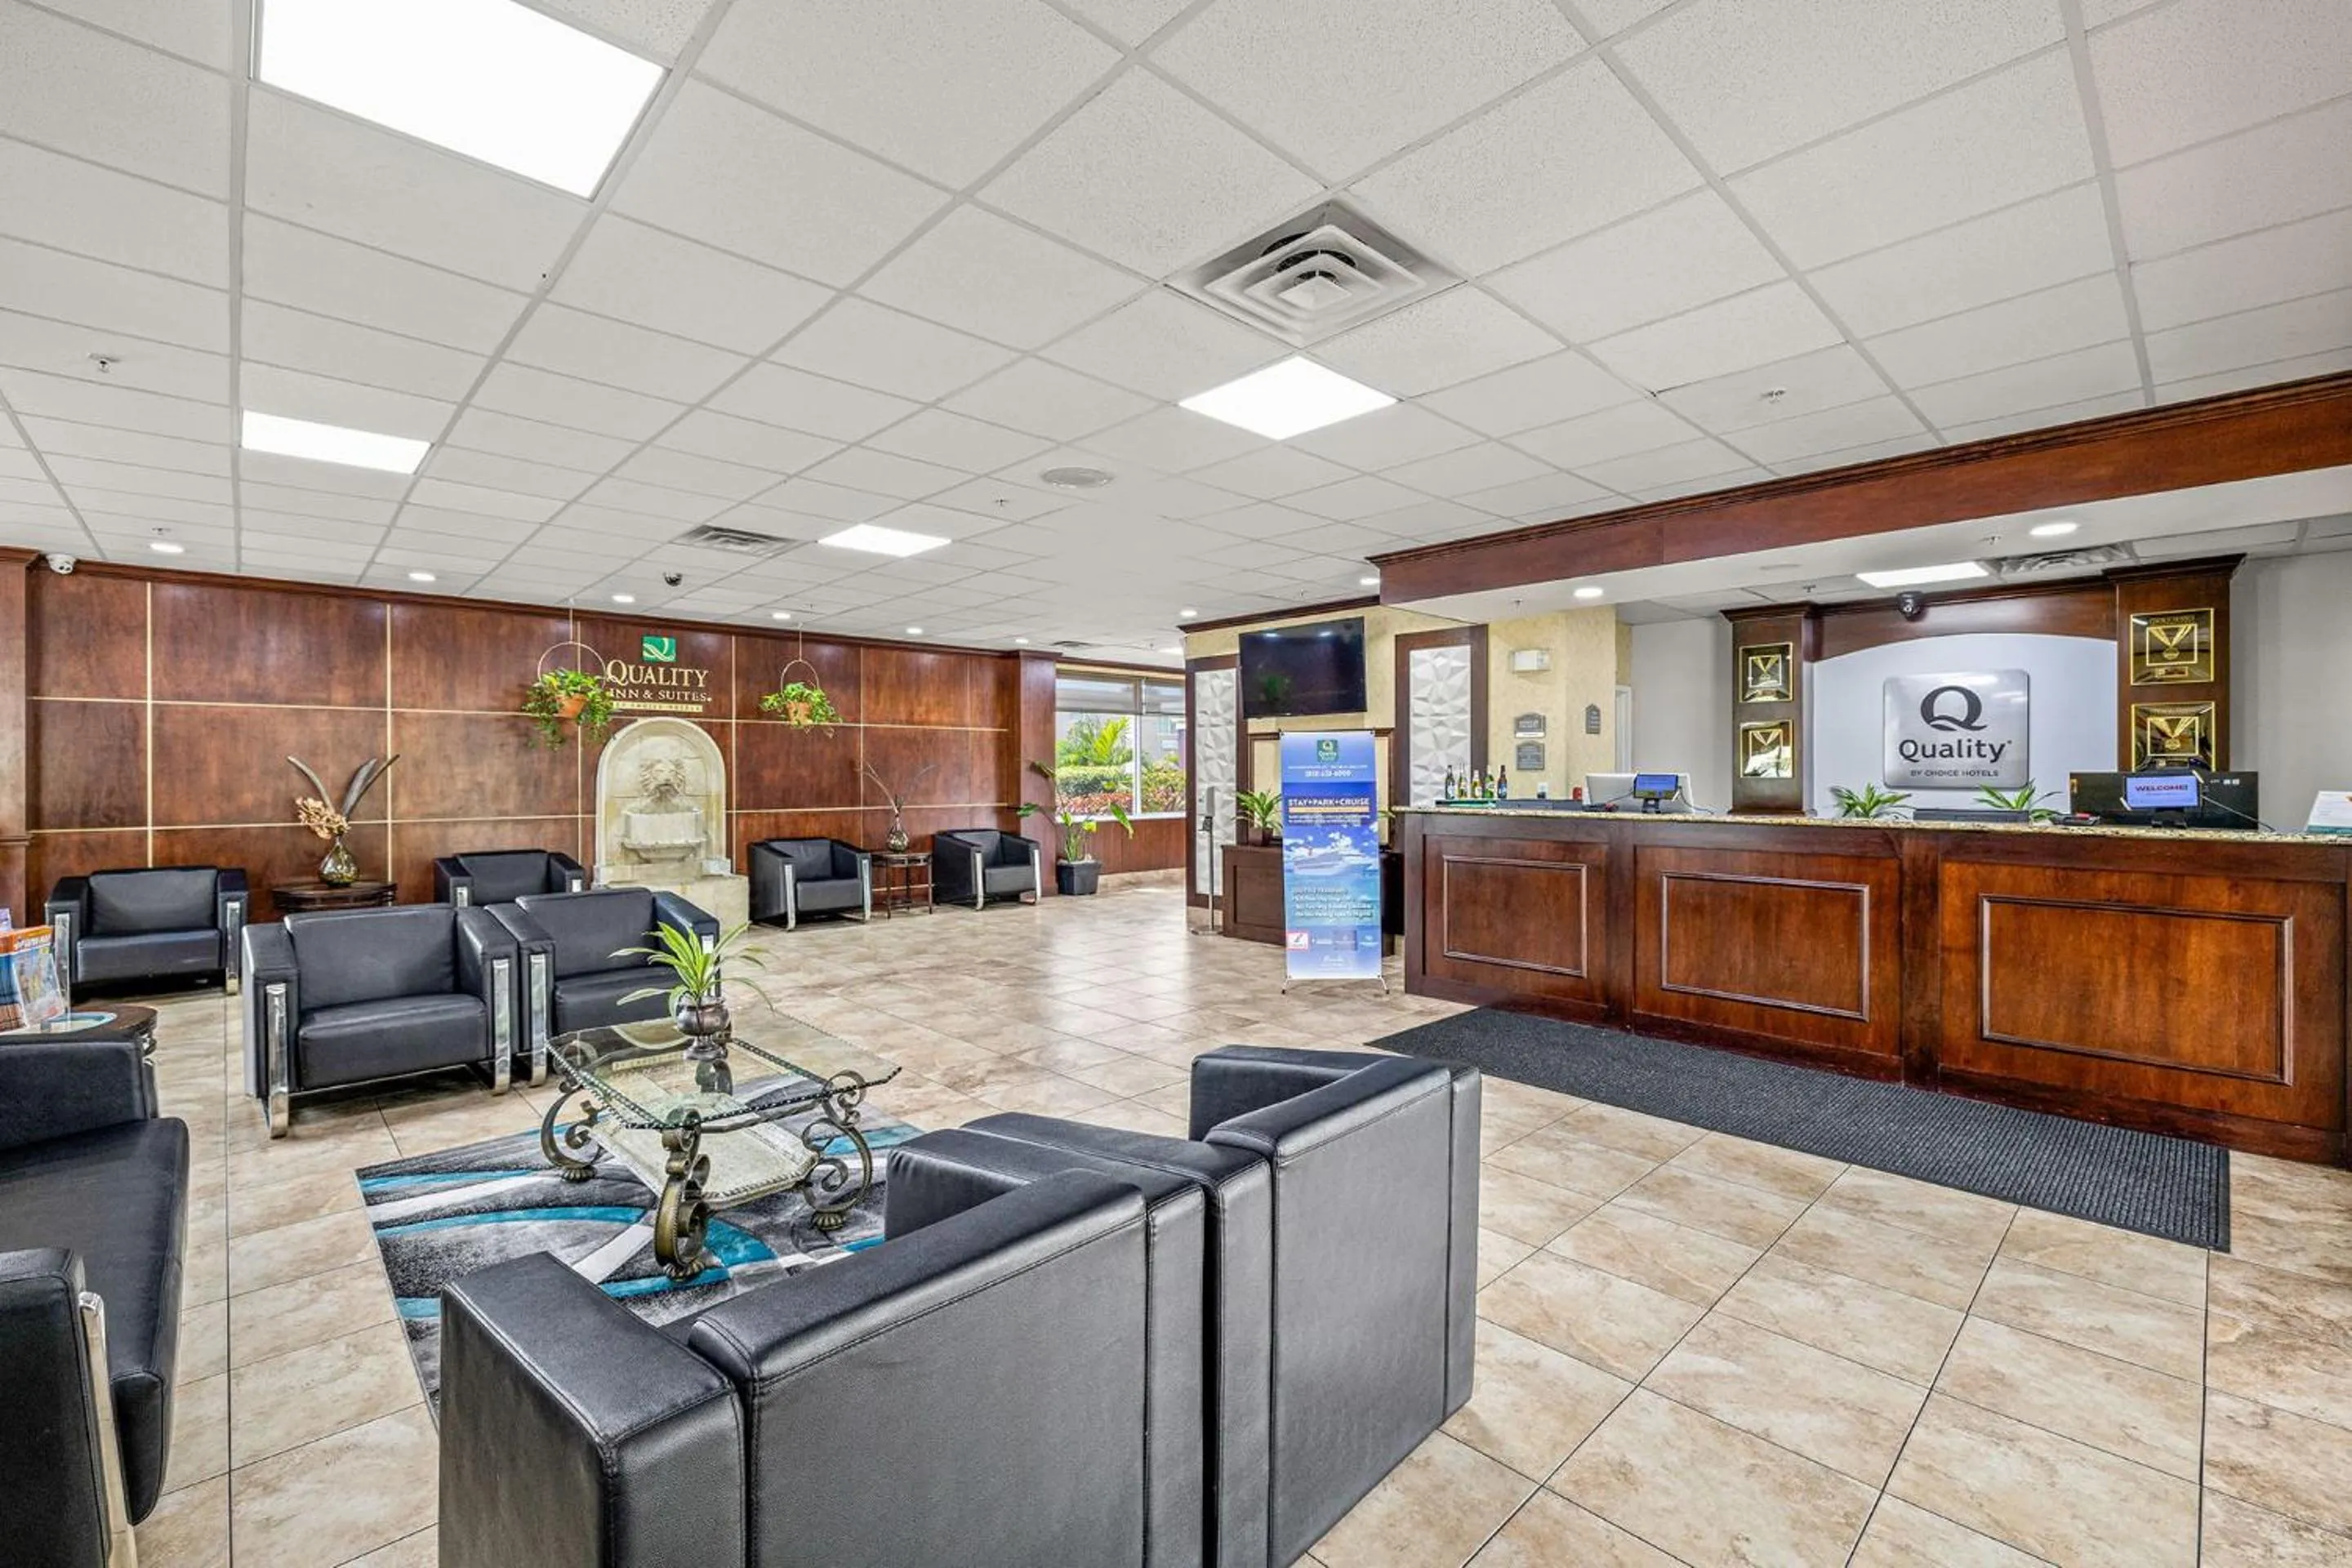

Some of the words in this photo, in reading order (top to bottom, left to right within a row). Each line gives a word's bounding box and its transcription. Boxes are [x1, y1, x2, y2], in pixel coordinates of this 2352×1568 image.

[607, 659, 709, 688] QUALITY
[610, 688, 639, 699] INN
[642, 689, 653, 700] &
[1899, 738, 2007, 764] Quality
